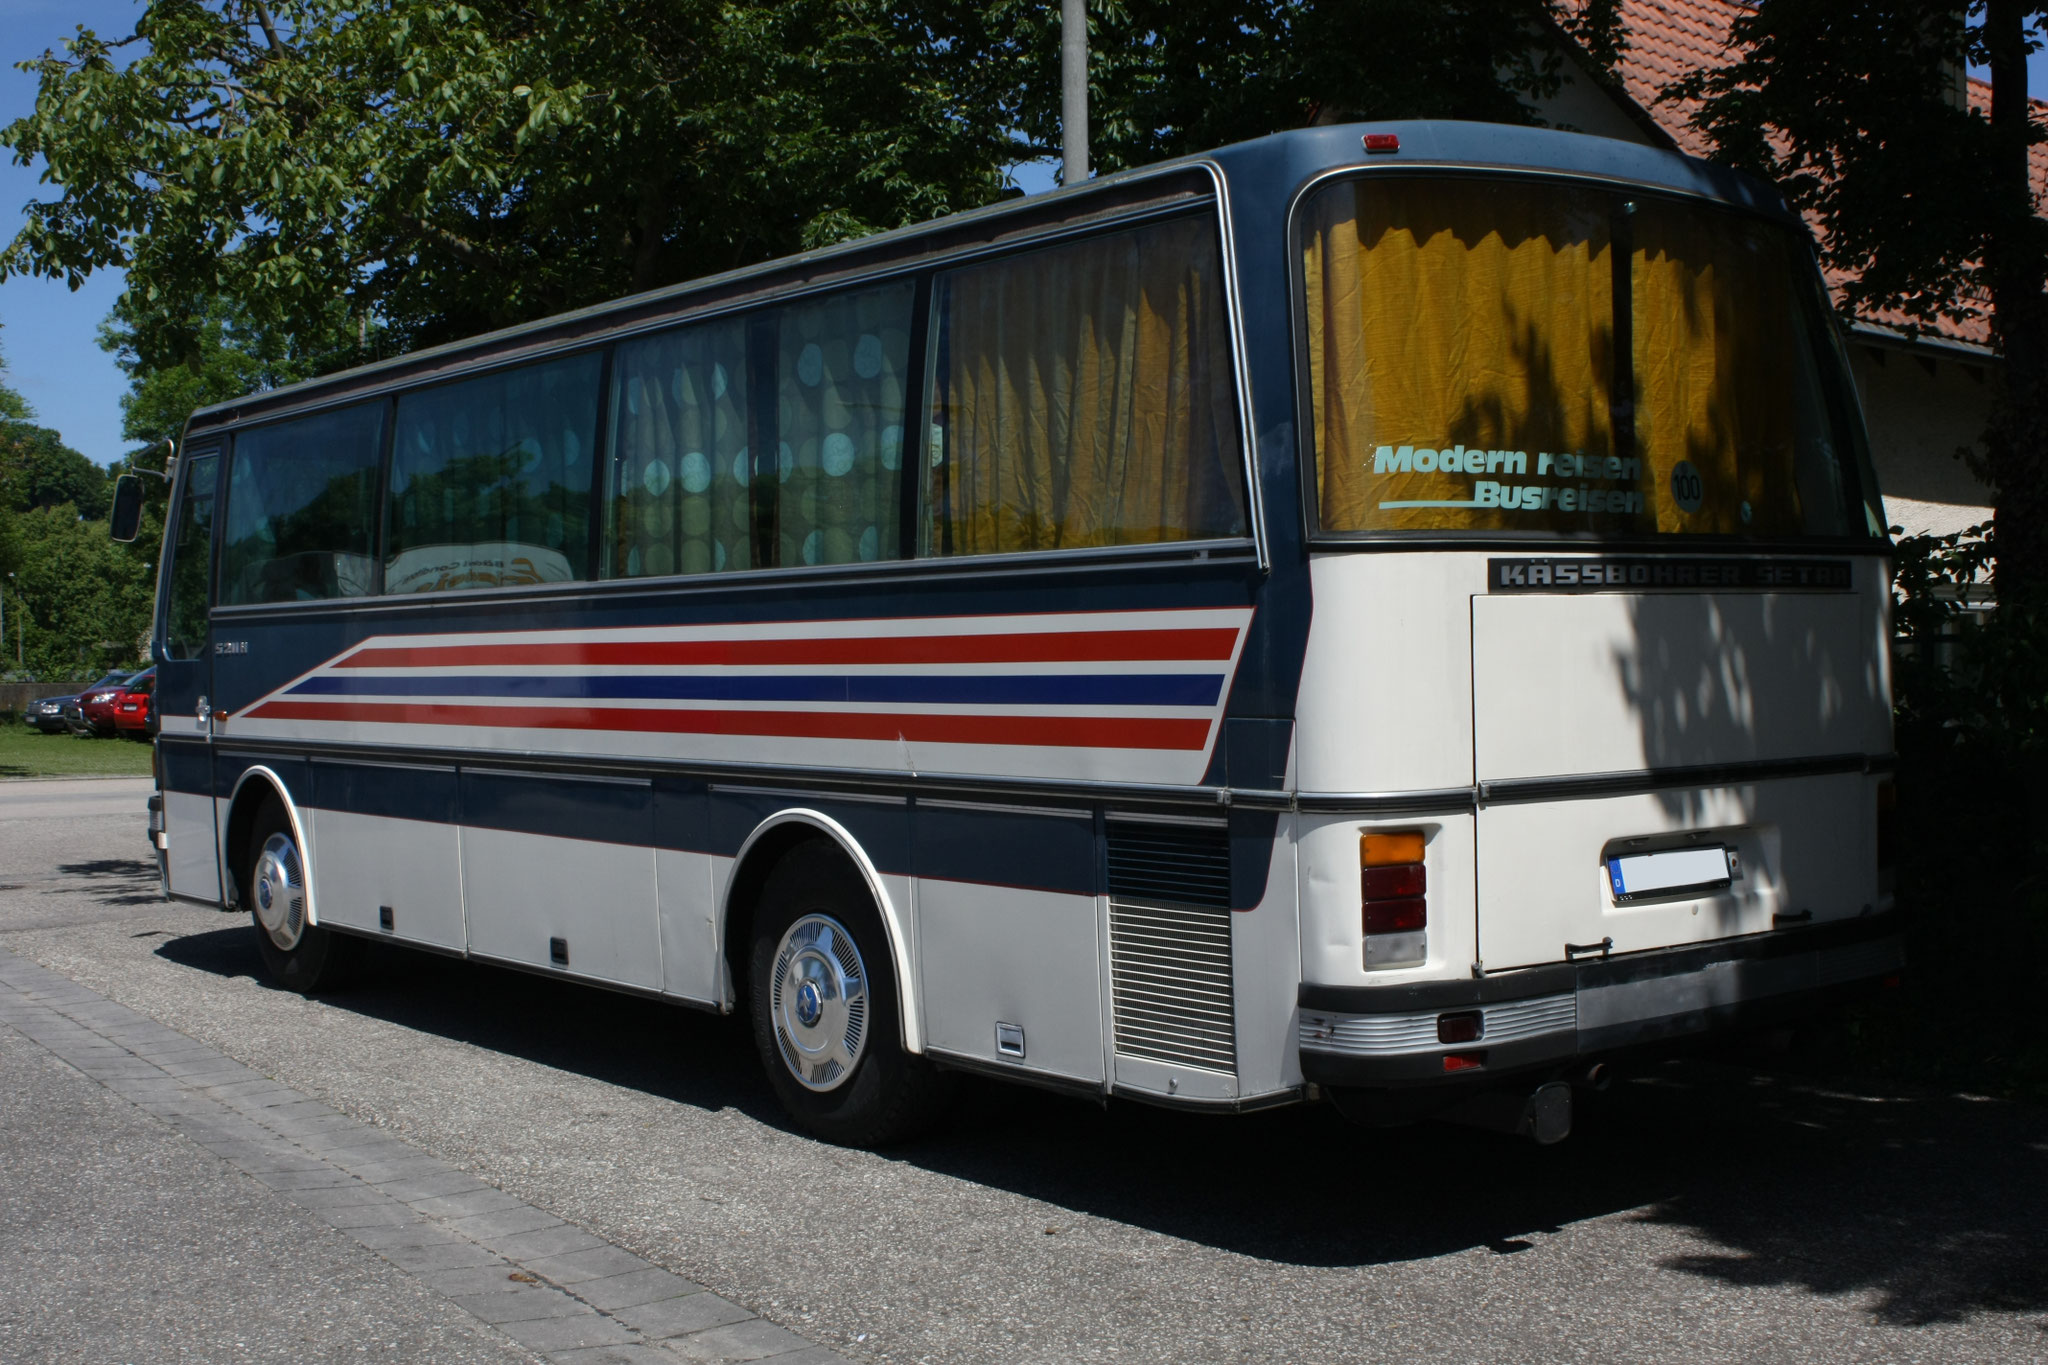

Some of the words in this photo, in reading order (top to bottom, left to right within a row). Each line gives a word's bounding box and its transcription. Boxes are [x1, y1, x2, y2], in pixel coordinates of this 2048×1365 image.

[1373, 445, 1527, 475] Modern
[1537, 447, 1642, 480] reisen
[1474, 481, 1643, 513] Busreisen
[1674, 475, 1701, 501] 100
[1500, 558, 1741, 585] KÄSSBOHRER
[1614, 878, 1622, 888] D
